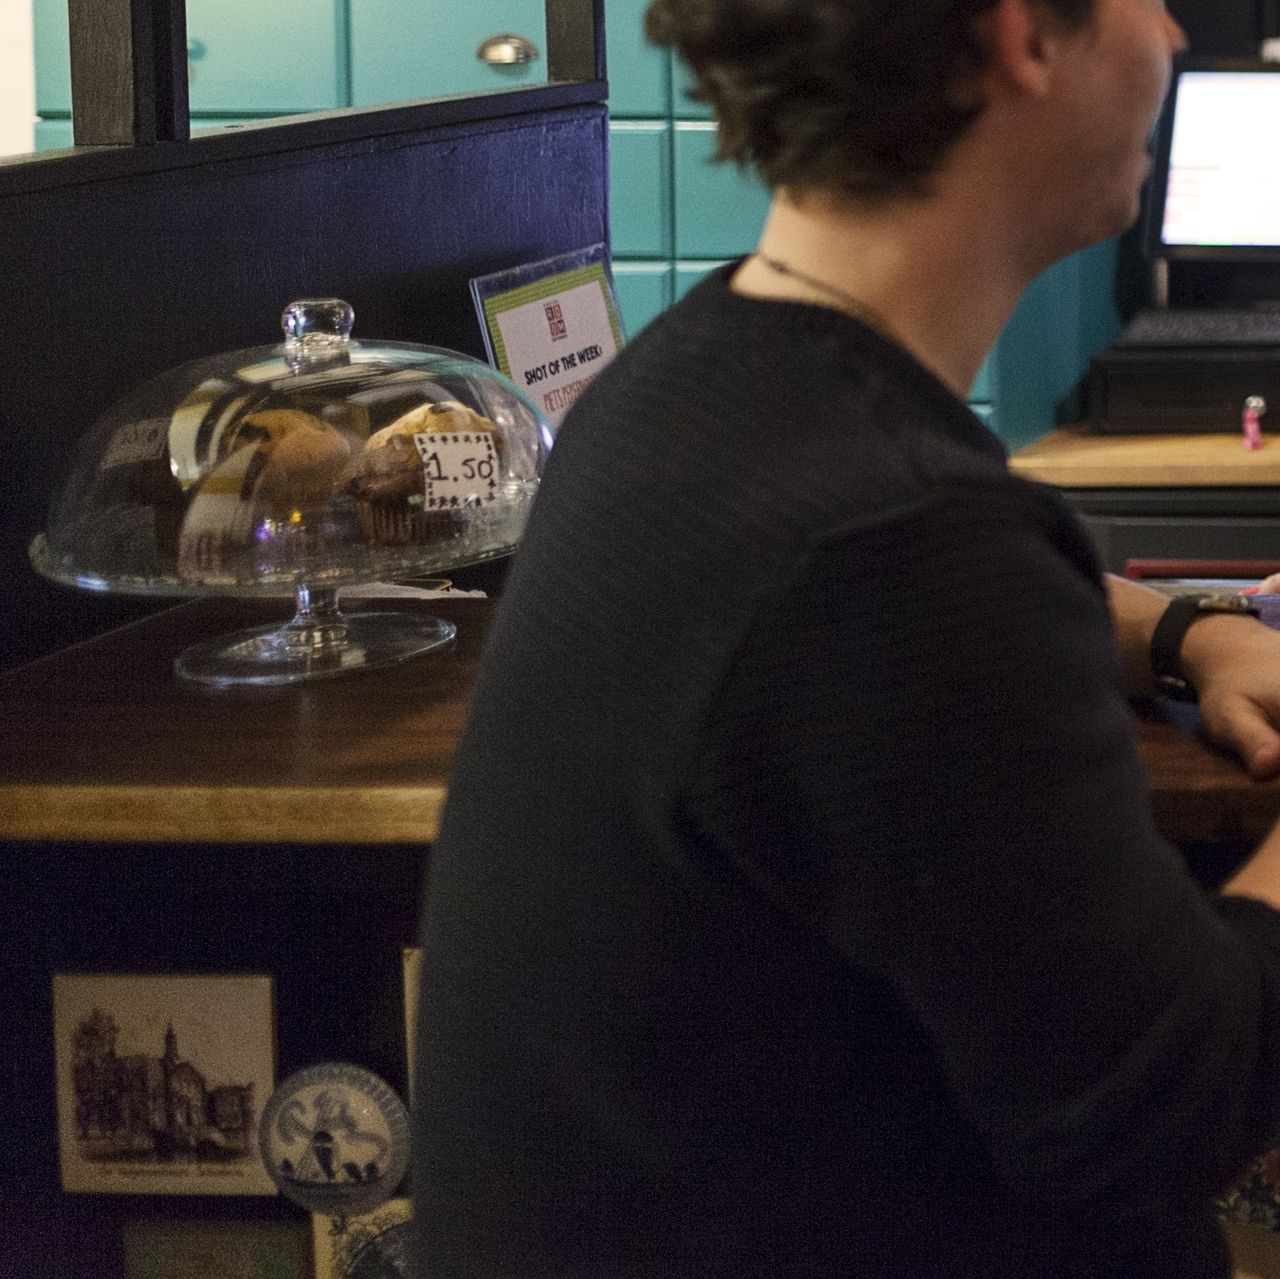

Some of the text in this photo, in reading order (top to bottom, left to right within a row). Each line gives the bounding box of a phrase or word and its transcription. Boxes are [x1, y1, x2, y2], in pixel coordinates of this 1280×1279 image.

[525, 364, 547, 385] SHOT
[550, 359, 562, 376] OF
[562, 353, 577, 371] THE
[428, 452, 493, 482] 1.50
